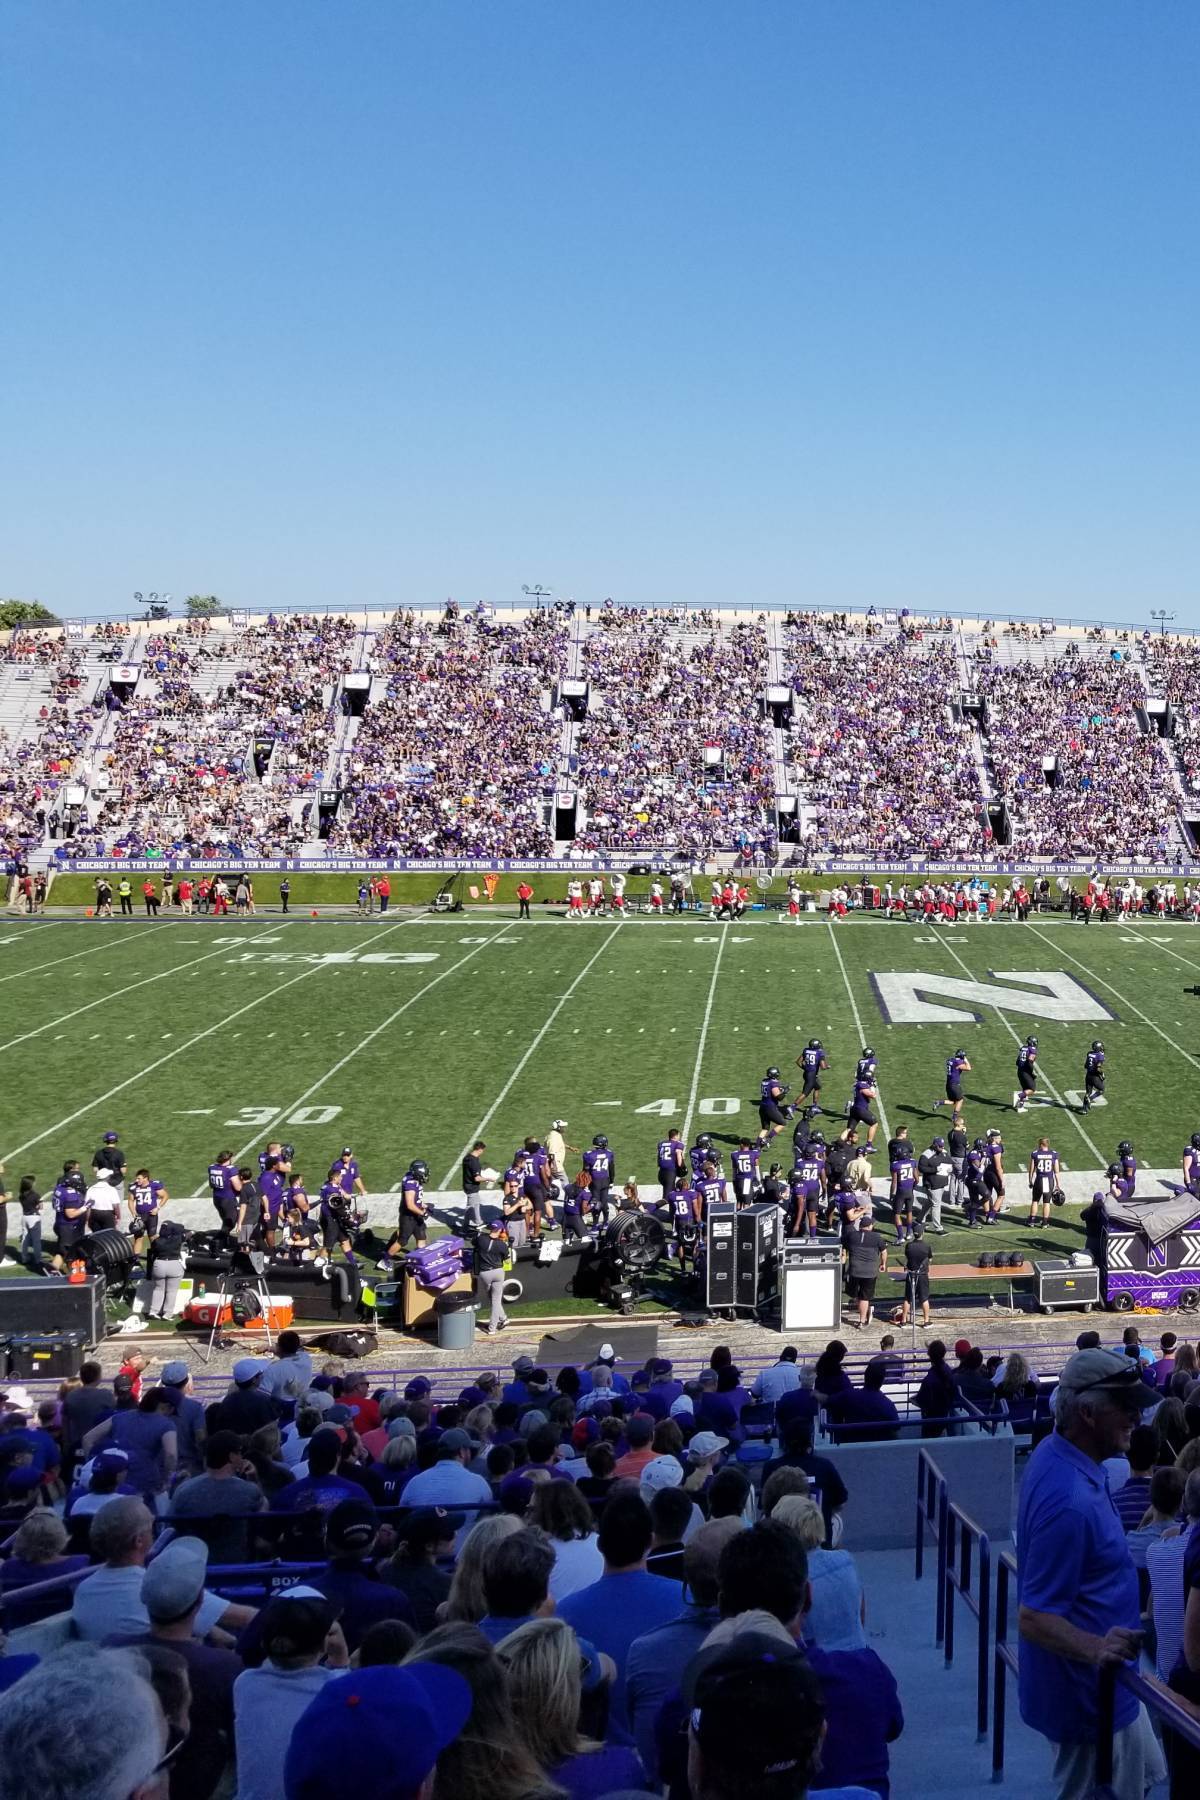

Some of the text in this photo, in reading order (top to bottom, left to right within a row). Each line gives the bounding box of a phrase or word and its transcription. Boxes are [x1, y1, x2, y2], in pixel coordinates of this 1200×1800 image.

[62, 861, 69, 870] N
[76, 861, 170, 869] CHICAGO'S BIG TEN TEAM
[176, 861, 184, 870] N
[287, 861, 294, 870] N
[393, 861, 400, 870] N
[498, 861, 504, 870] N
[598, 862, 605, 870] N
[1003, 864, 1009, 872] N
[869, 970, 1118, 1023] N
[634, 1097, 740, 1116] 40
[224, 1105, 343, 1126] 30
[593, 1160, 609, 1172] 44
[1038, 1160, 1052, 1172] 48
[803, 1168, 818, 1180] 94
[900, 1168, 913, 1180] 24
[136, 1193, 152, 1205] 34
[706, 1189, 719, 1202] 21
[675, 1201, 688, 1215] 18
[1148, 1240, 1167, 1267] N
[200, 1310, 209, 1320] G
[272, 1576, 300, 1586] BOX
